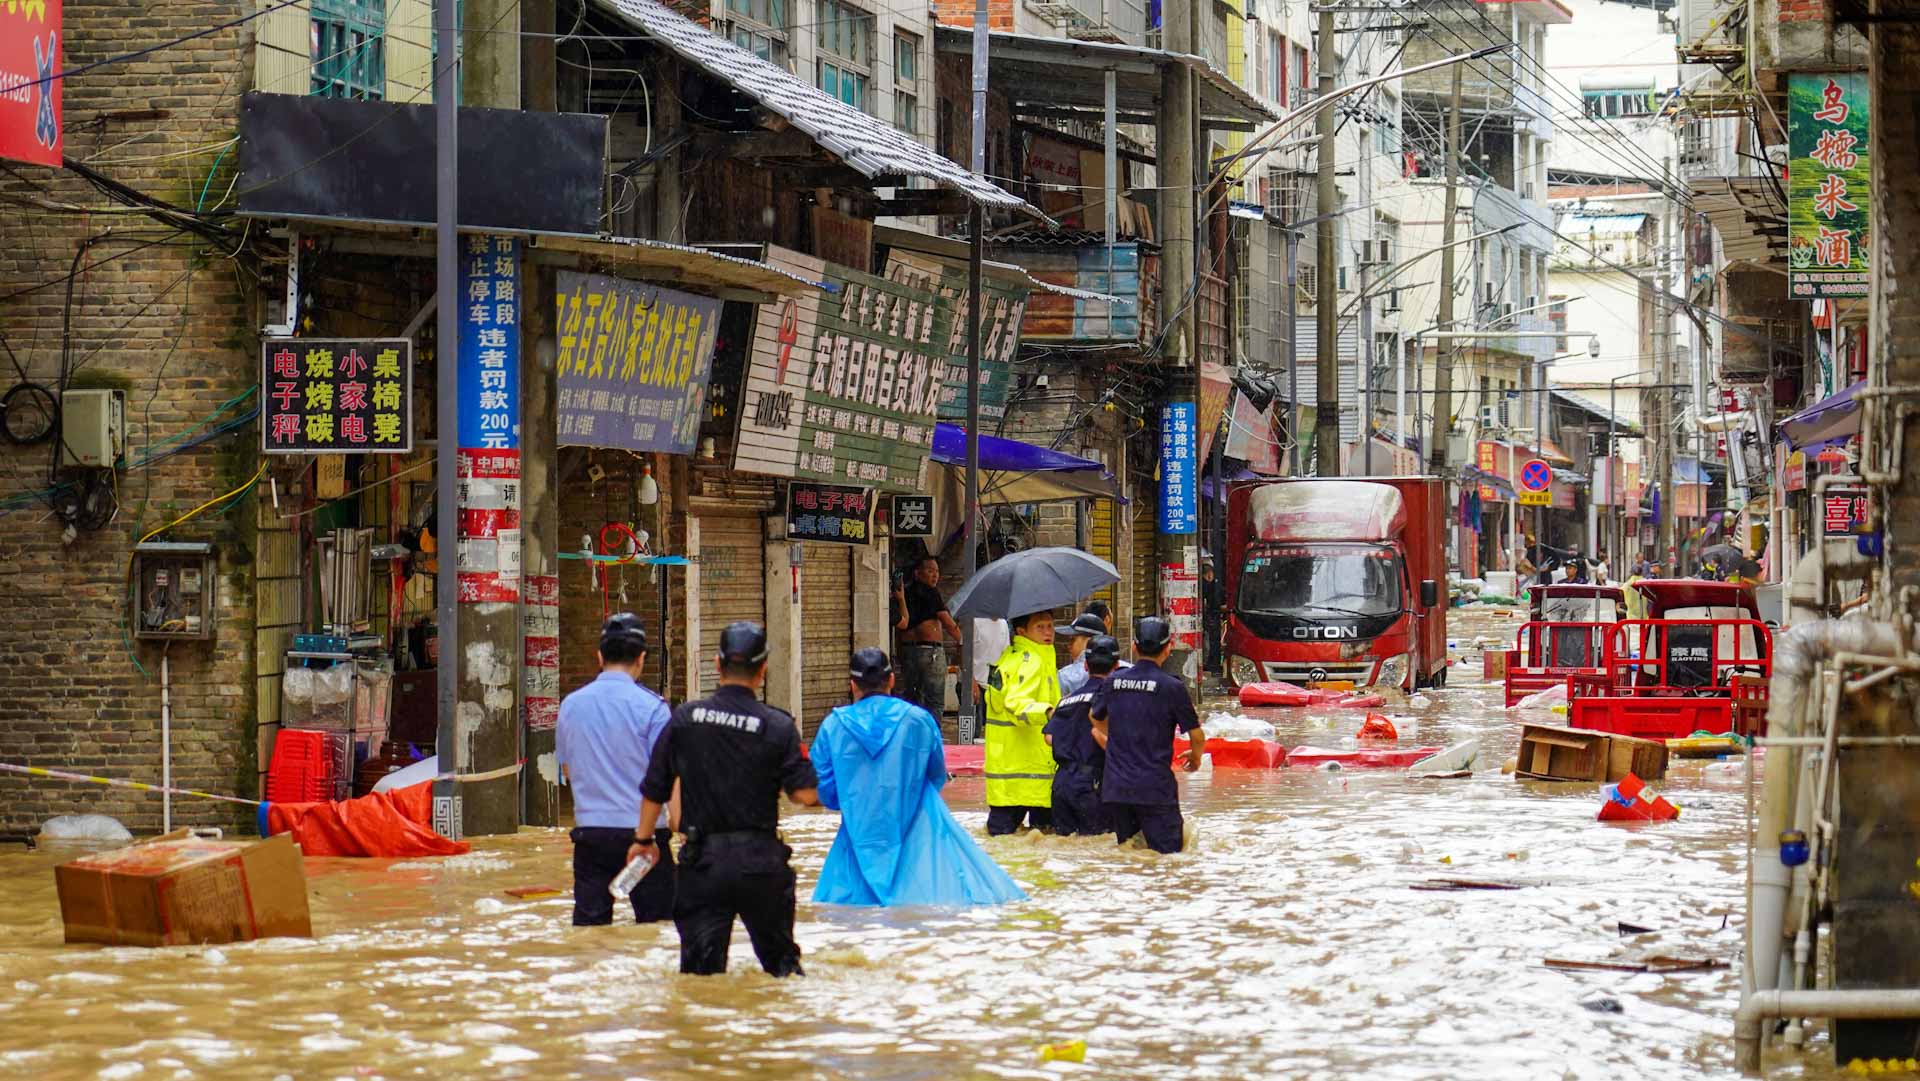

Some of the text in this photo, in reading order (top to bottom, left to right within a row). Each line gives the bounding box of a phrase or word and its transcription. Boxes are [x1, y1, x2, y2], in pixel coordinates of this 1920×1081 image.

[0, 70, 31, 104] 11520
[1810, 78, 1858, 268] 乌糯米酒
[468, 235, 491, 326] 禁止停车
[494, 235, 515, 325] 市场路段
[840, 282, 935, 344] 公牛安全插座
[272, 348, 300, 444] 电子秤
[305, 348, 334, 444] 烧烤碳
[339, 348, 368, 444] 小家电
[372, 348, 401, 444] 桌椅凳
[477, 328, 510, 449] 违者罚款200元
[811, 330, 945, 416] 宏源日用百货批发
[1162, 407, 1173, 459] 禁止停车
[1174, 407, 1188, 459] 市场路段
[794, 513, 866, 539] 桌椅碗
[795, 488, 867, 514] 电子秤
[899, 500, 928, 531] 炭
[1166, 461, 1185, 531] 违者罚款200元
